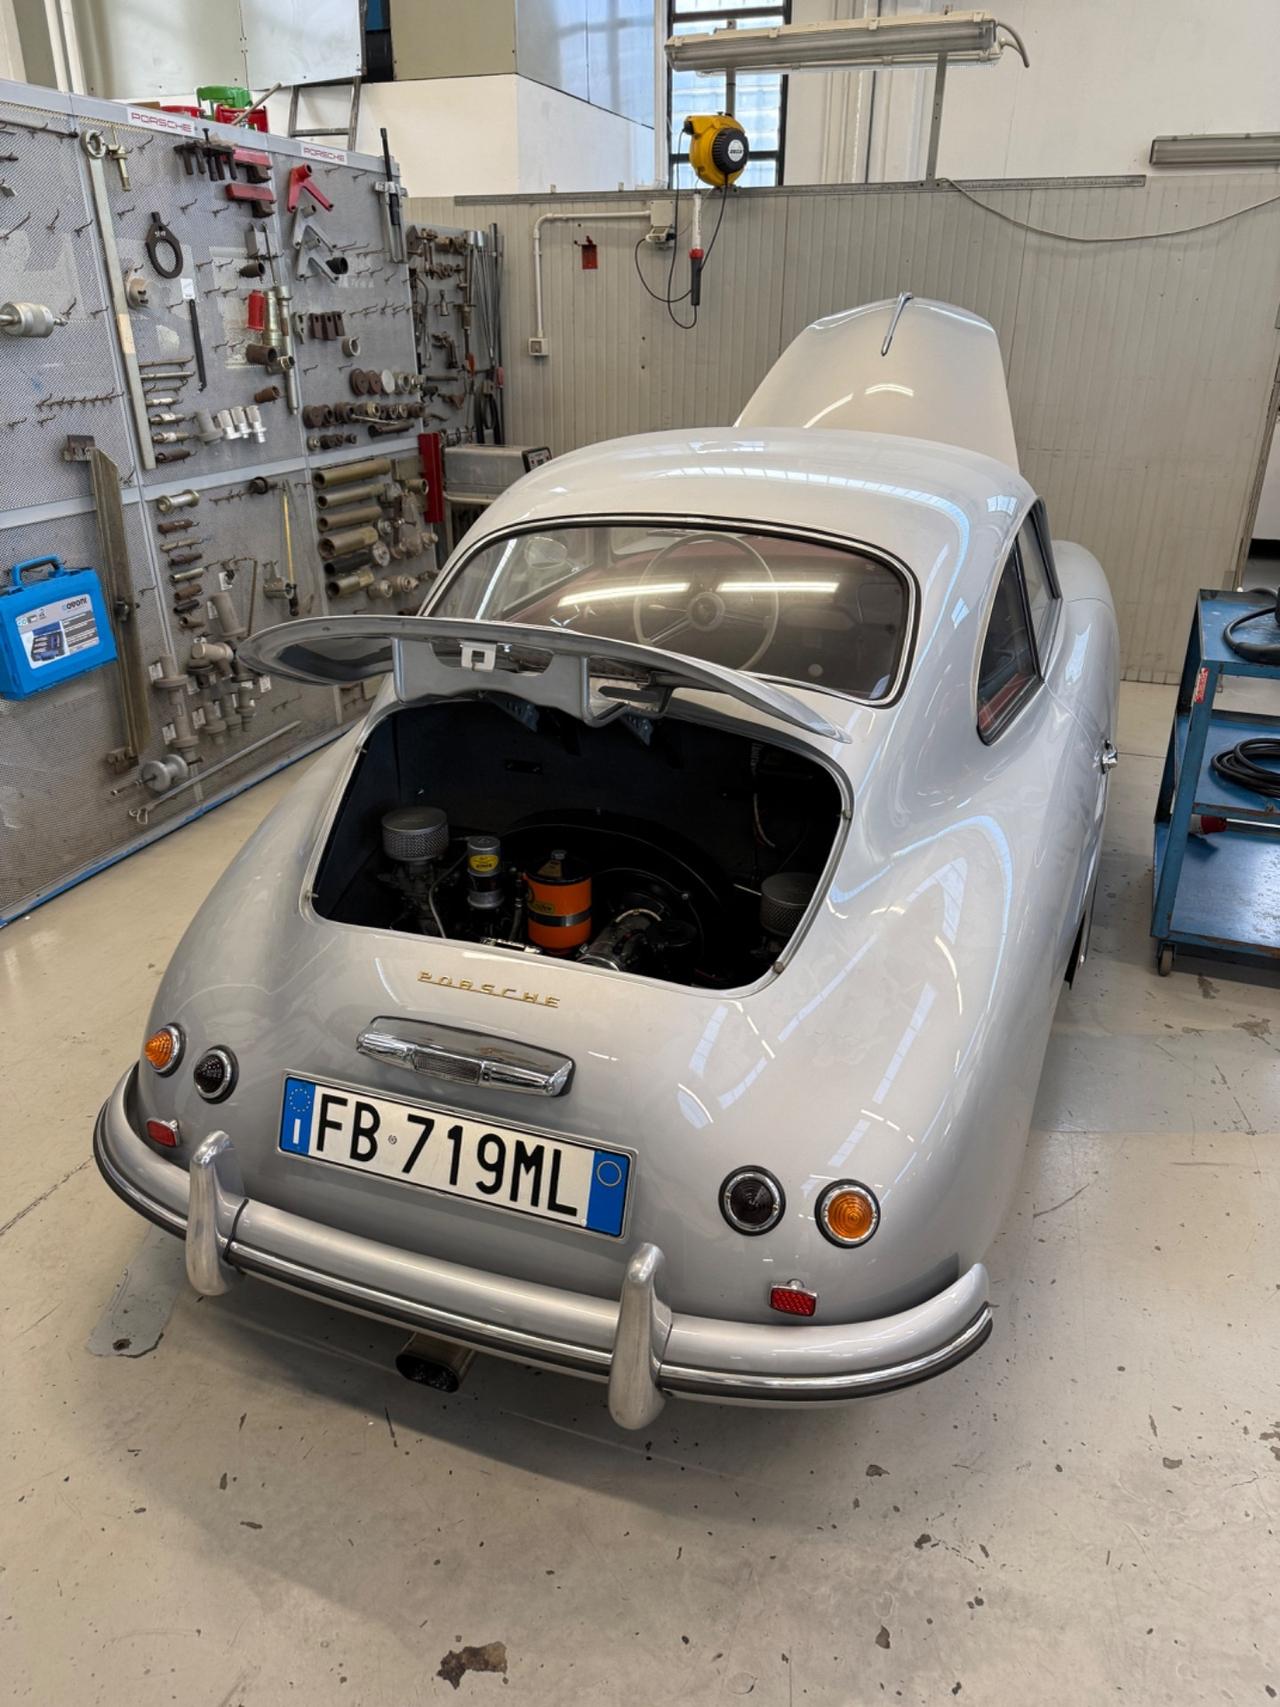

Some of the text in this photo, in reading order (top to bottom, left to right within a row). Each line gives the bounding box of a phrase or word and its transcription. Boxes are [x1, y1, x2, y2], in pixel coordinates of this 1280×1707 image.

[131, 111, 193, 133] PORSCHE
[416, 970, 561, 1009] PORSCHE
[315, 1093, 381, 1163] FB
